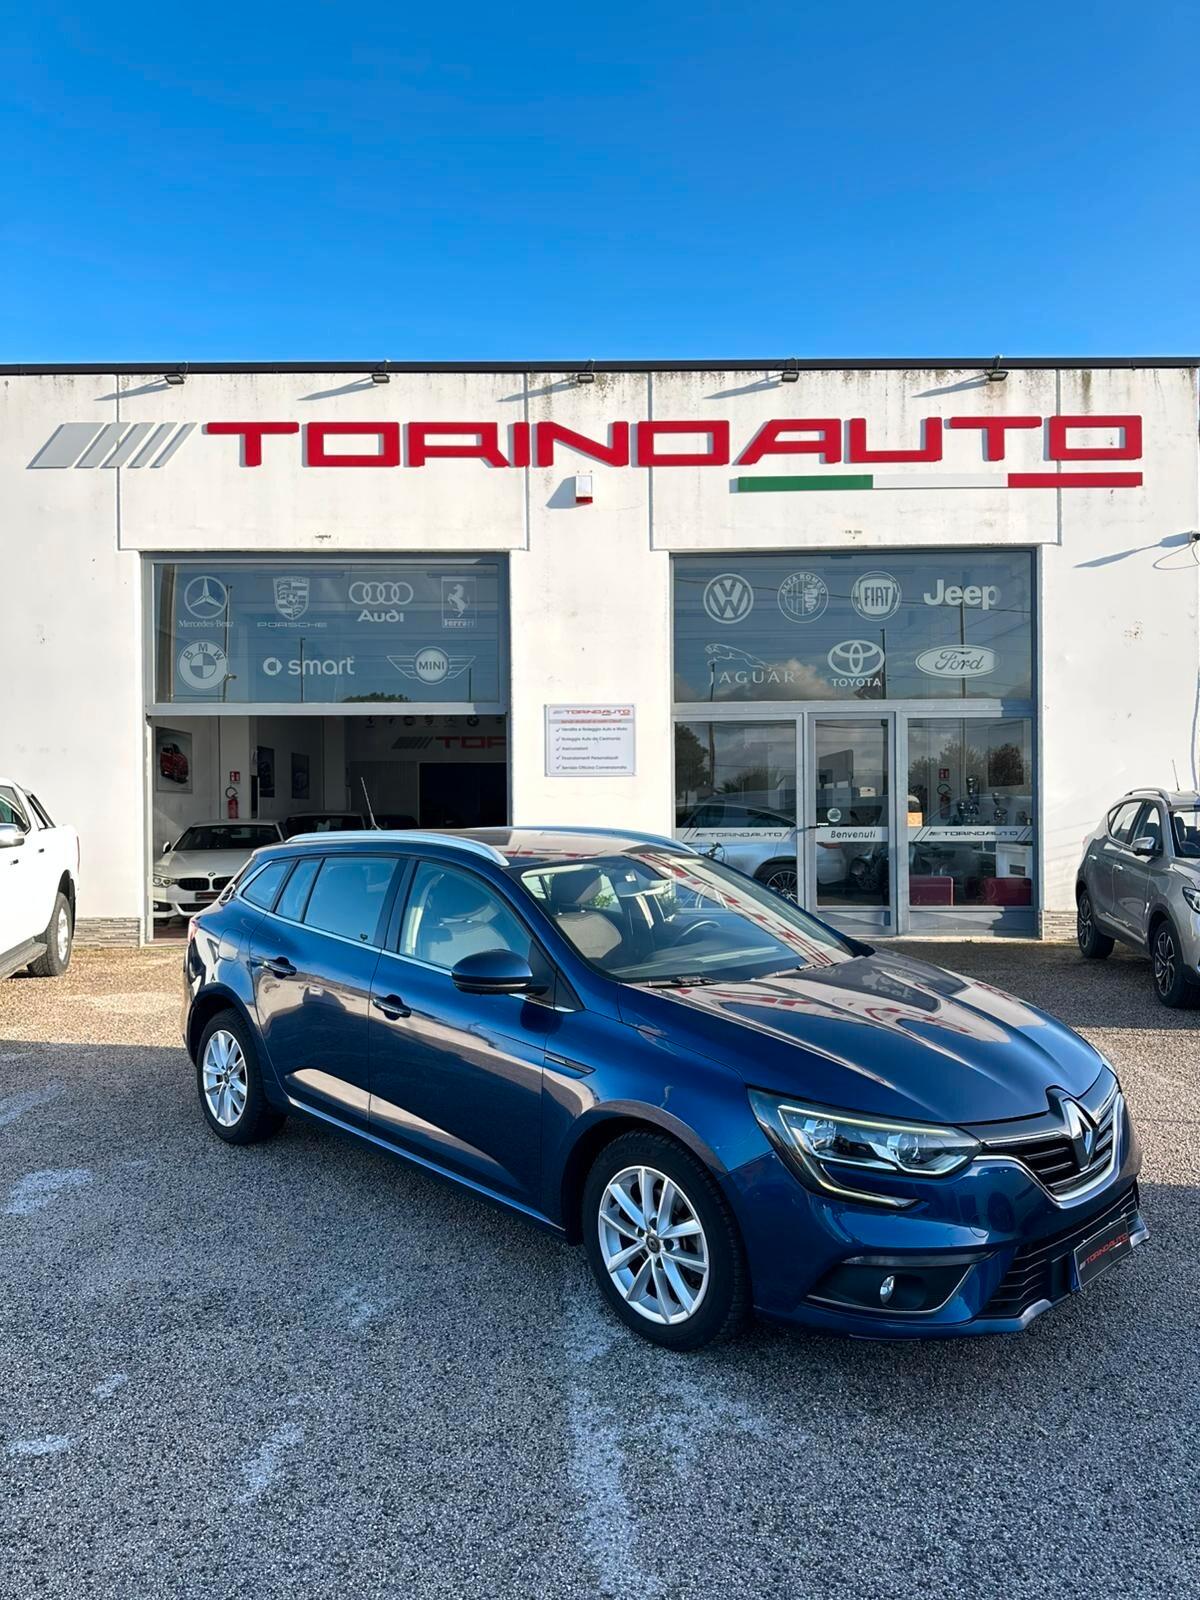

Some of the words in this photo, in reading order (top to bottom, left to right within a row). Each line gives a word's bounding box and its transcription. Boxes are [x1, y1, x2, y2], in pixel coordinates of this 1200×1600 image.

[204, 415, 1143, 468] TORINOAUTO
[864, 586, 891, 607] FIAT
[923, 579, 999, 610] Jeep
[178, 619, 234, 628] Mercedes-Benz
[357, 609, 404, 622] Audi
[183, 643, 225, 662] BMW
[934, 650, 984, 672] Ford
[288, 657, 355, 675] smart
[418, 661, 445, 671] MINI
[709, 670, 796, 686] JAGUAR
[832, 677, 882, 687] TOYOTA
[830, 830, 877, 839] Benvenuti
[1085, 1232, 1129, 1264] TORINOAUTO
